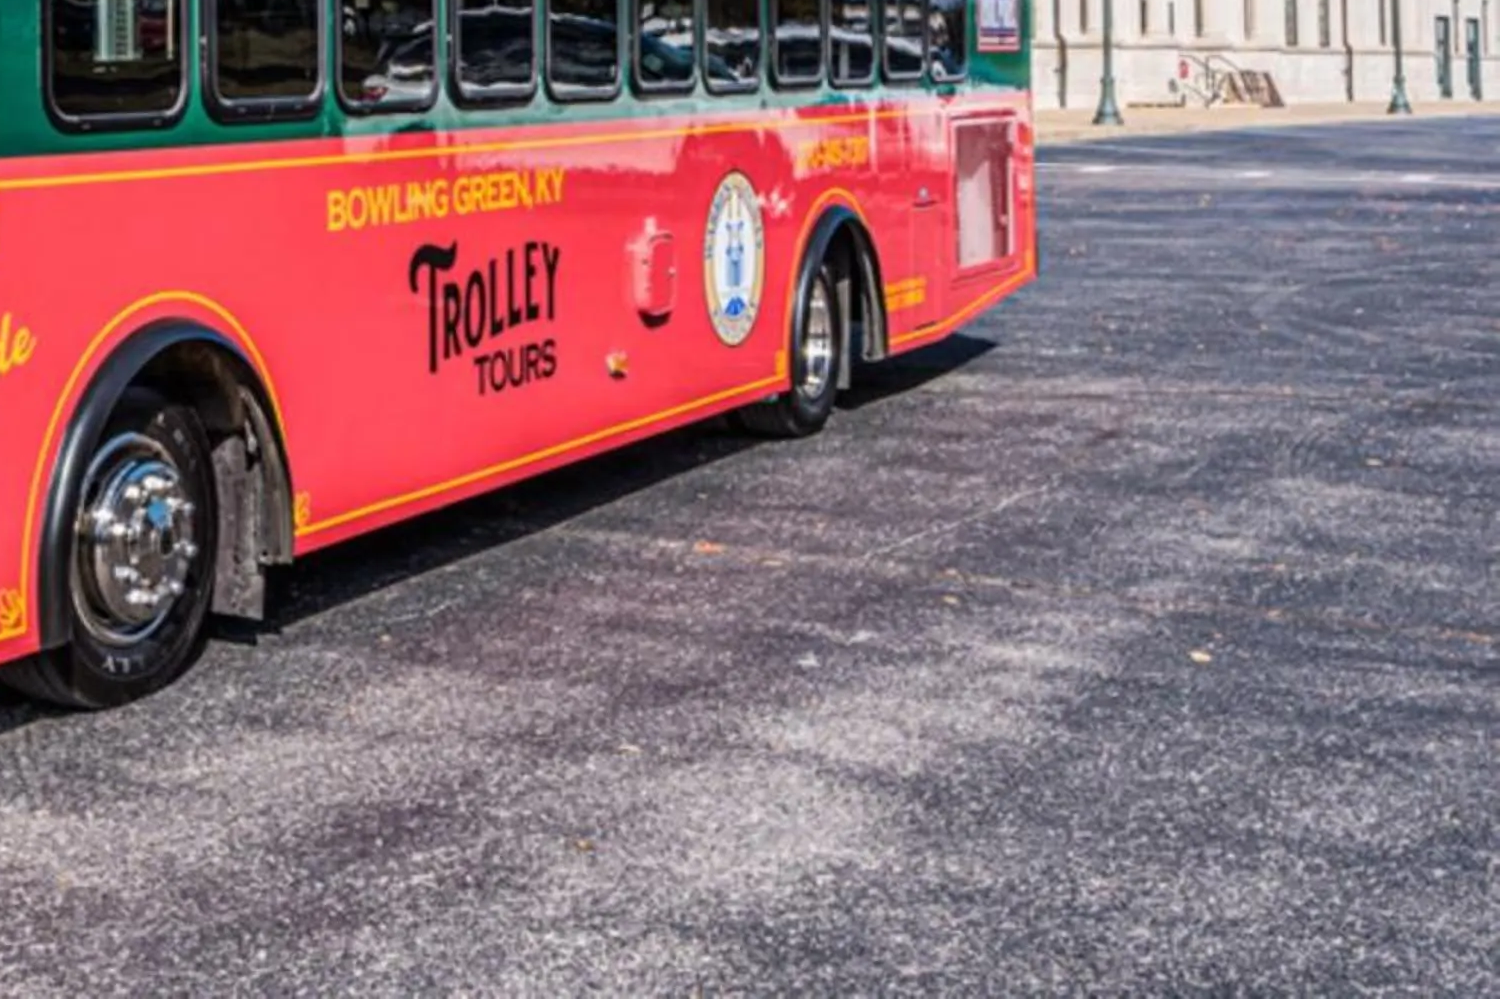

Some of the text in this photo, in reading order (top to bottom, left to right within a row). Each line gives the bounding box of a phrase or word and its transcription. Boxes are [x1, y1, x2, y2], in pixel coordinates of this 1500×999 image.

[326, 166, 566, 232] BOWLING GREEN, KY
[408, 239, 561, 375] TROLLEY
[473, 338, 557, 396] TOURS
